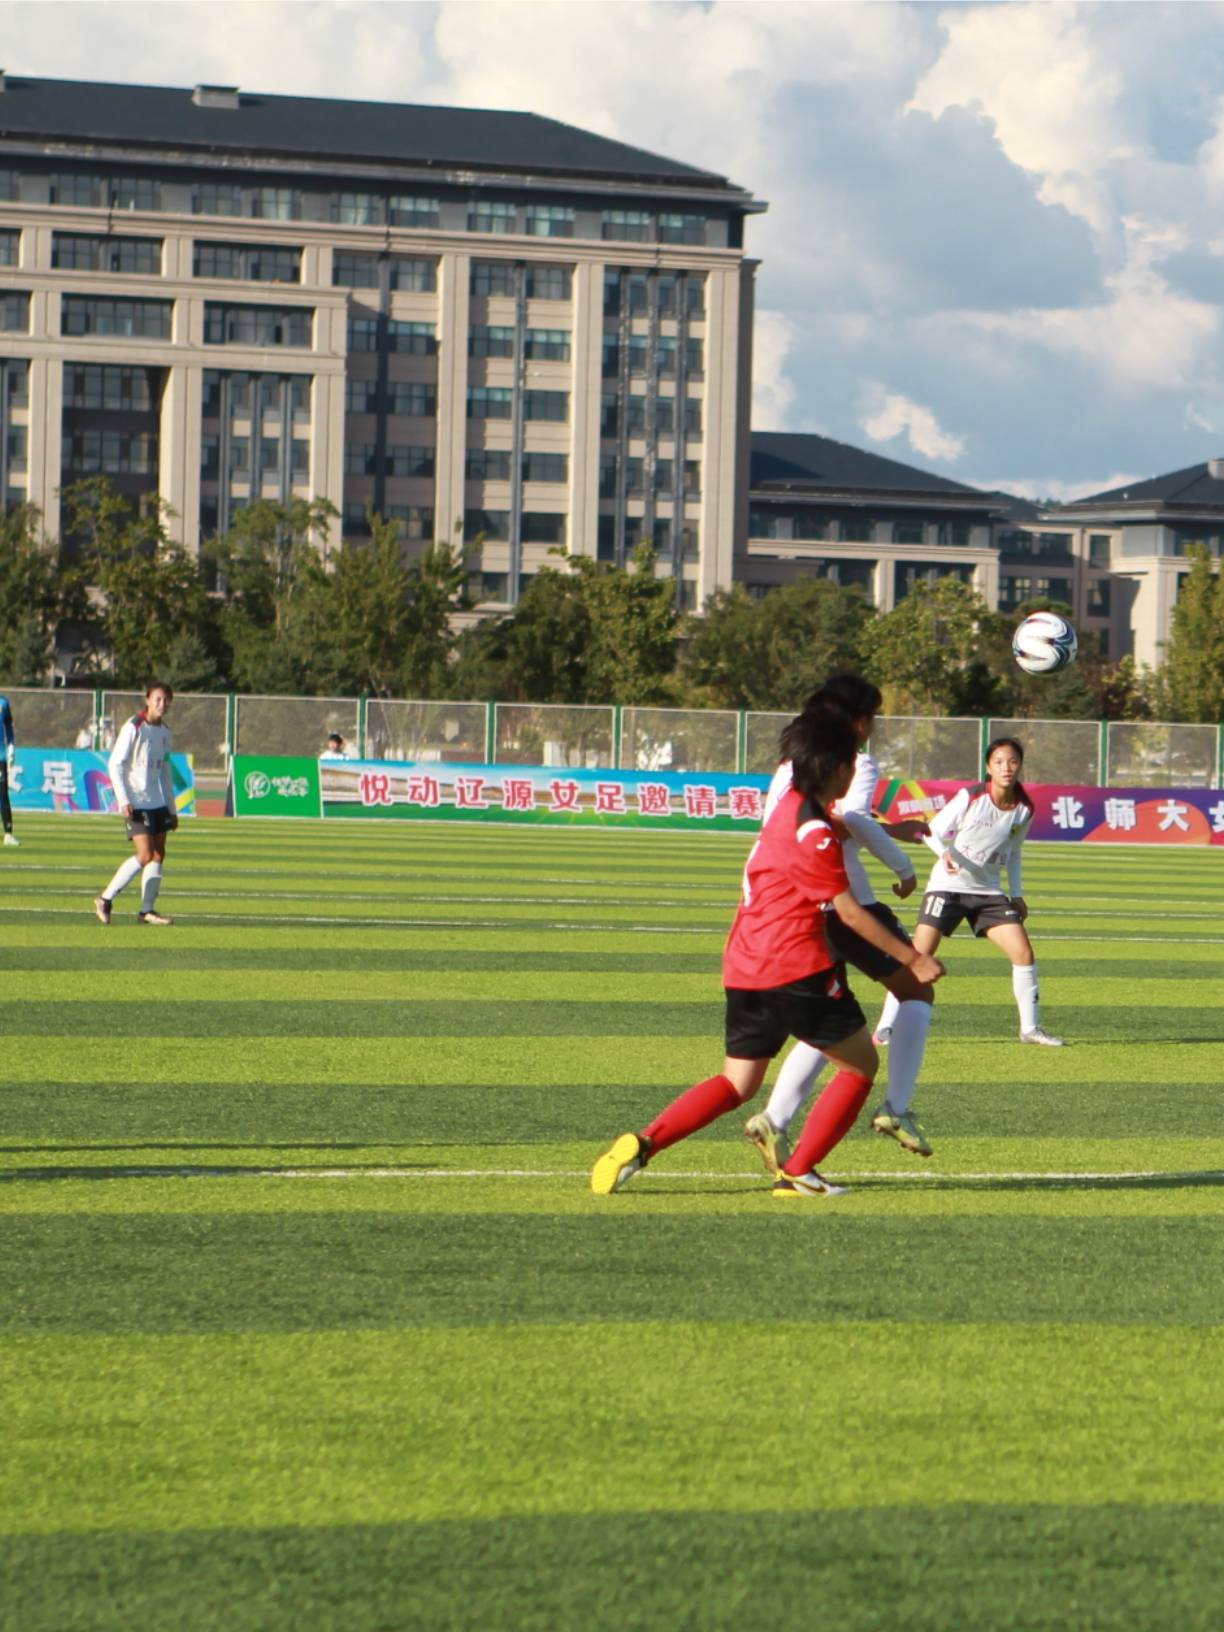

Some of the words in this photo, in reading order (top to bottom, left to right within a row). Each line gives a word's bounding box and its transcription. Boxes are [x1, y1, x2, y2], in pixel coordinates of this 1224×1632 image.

[359, 773, 763, 818] 悦动辽源女足邀请赛
